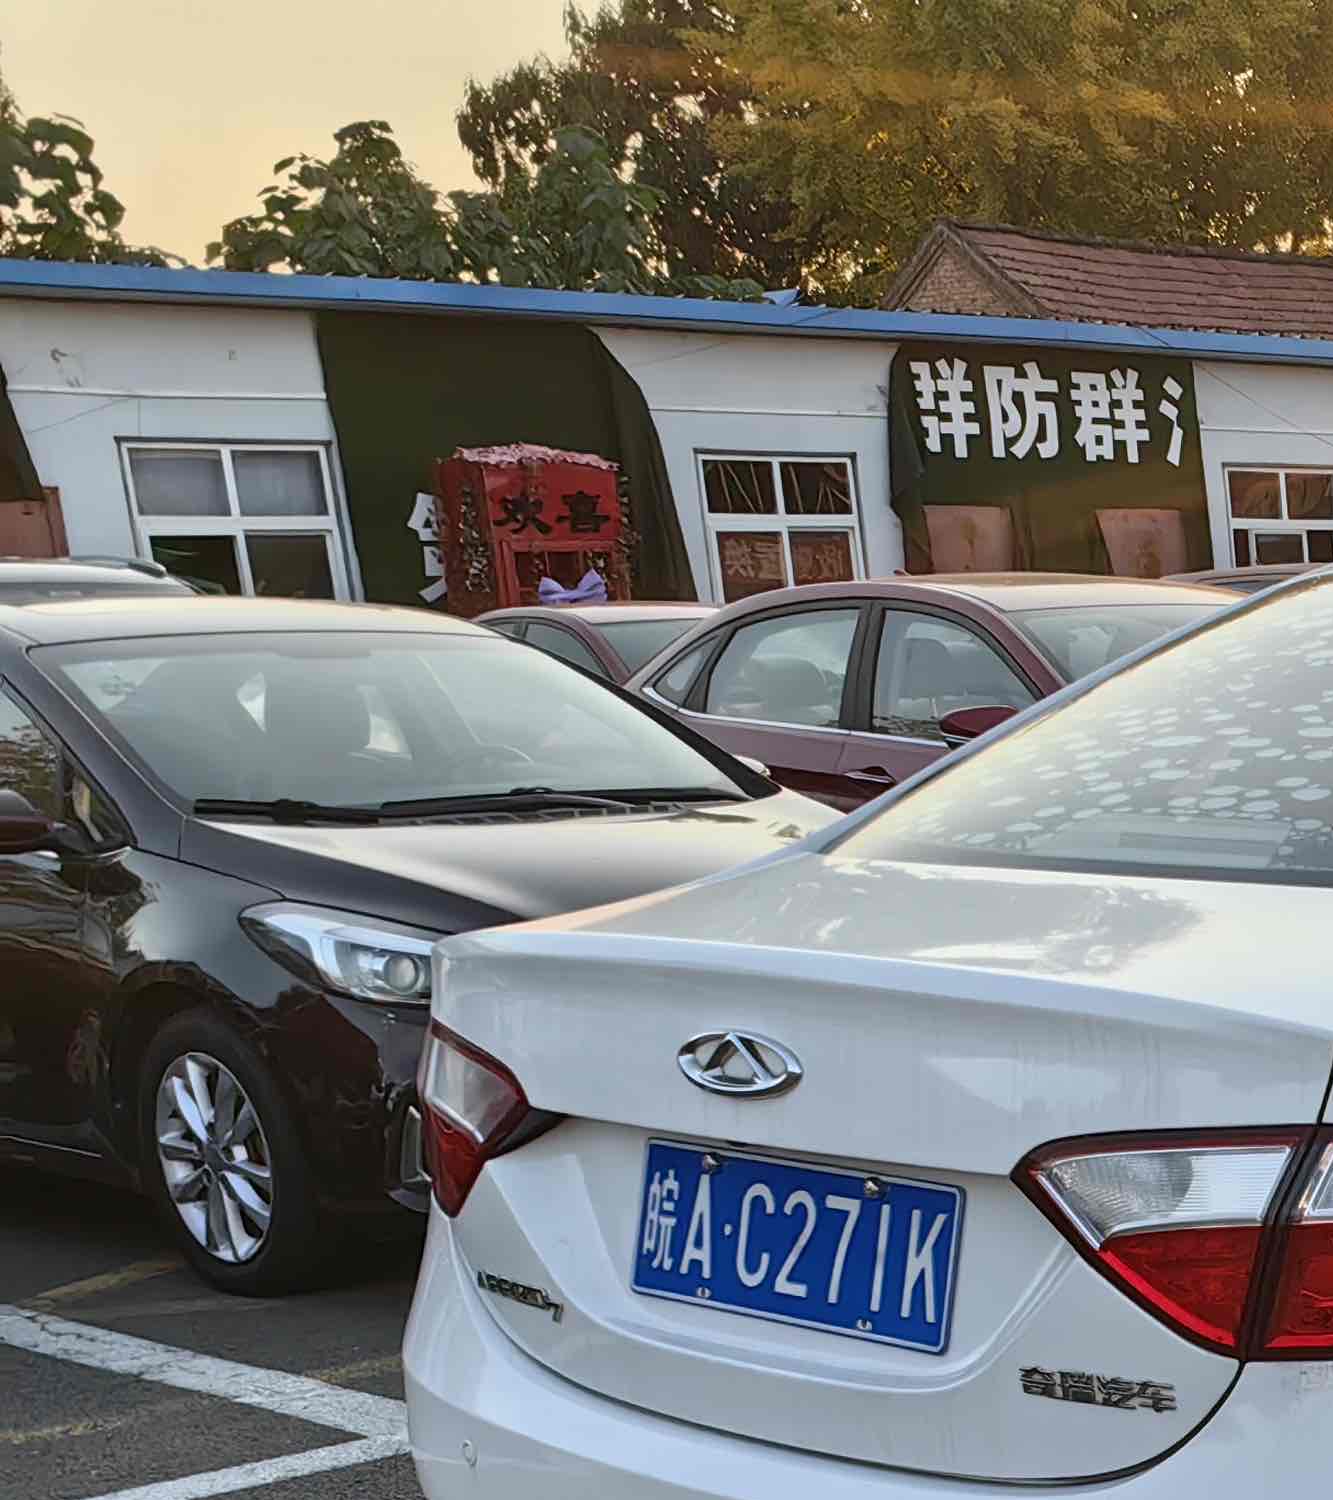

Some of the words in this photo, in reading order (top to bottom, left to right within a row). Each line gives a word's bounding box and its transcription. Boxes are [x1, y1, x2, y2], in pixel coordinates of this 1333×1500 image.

[642, 1168, 949, 1324] 皖A·C271K
[1018, 1366, 1178, 1413] 奇瑞汽车
